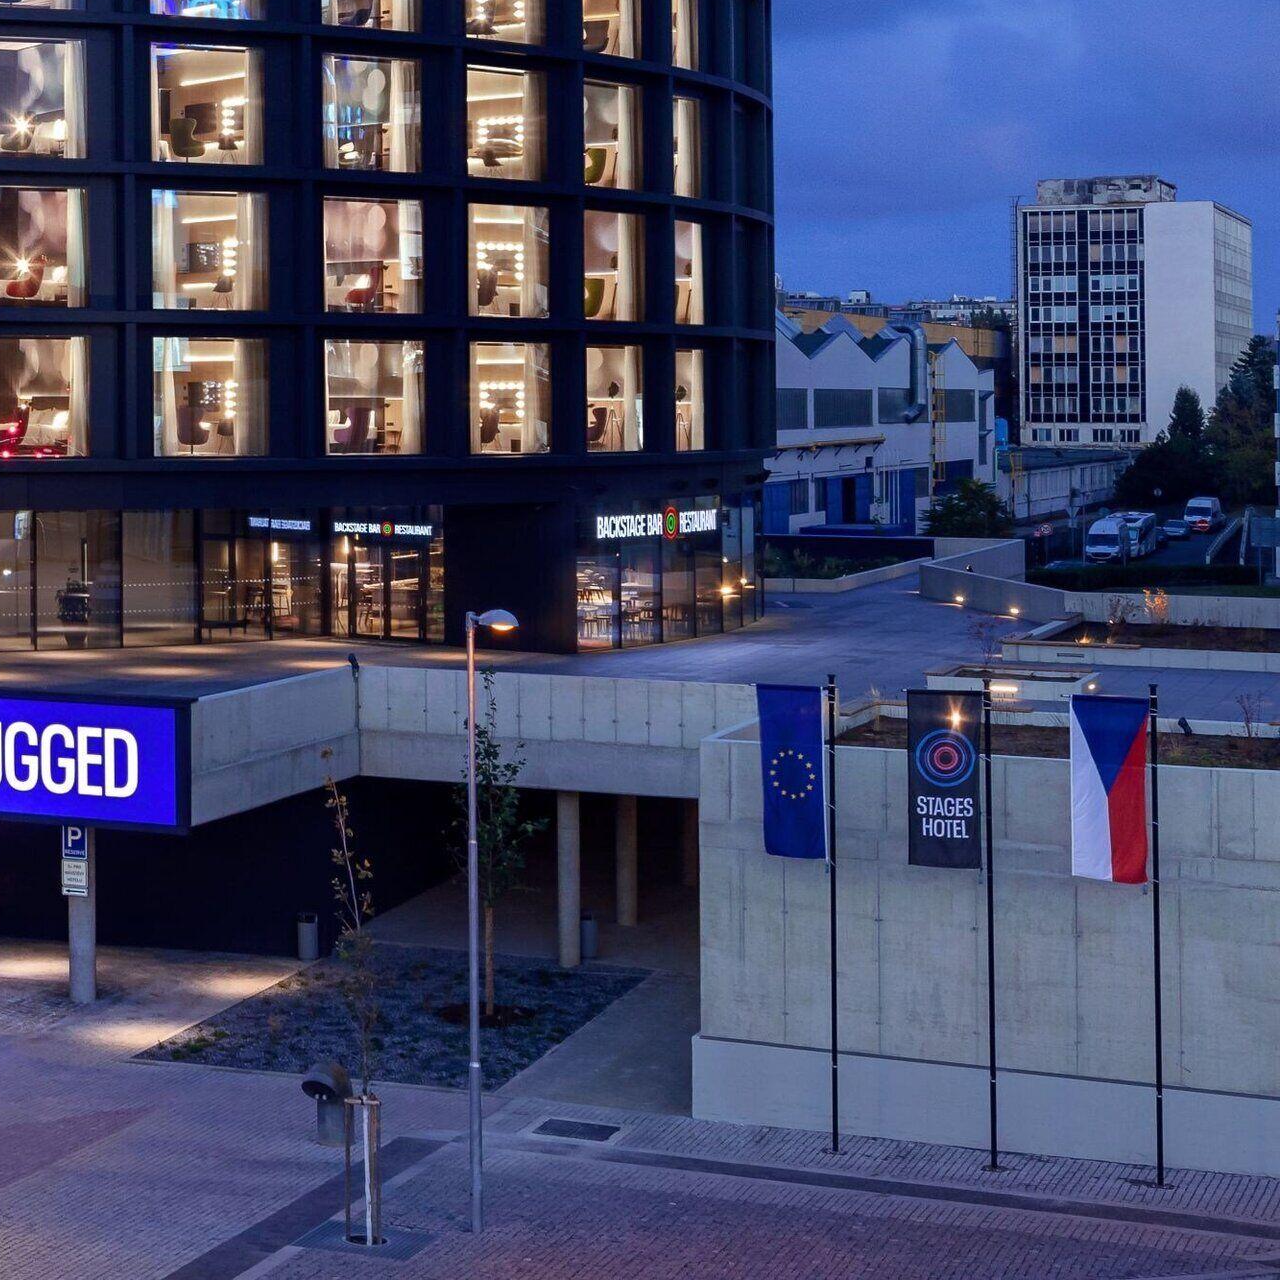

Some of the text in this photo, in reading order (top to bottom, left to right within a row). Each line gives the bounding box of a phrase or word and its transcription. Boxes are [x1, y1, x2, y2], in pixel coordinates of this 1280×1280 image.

[334, 522, 432, 536] BACKSTAGE BAR RESTAURANT
[597, 509, 717, 539] BACKSTAGE BAR RESTAURANT
[916, 795, 973, 817] STAGES
[67, 826, 82, 848] P
[922, 818, 969, 839] HOTEL
